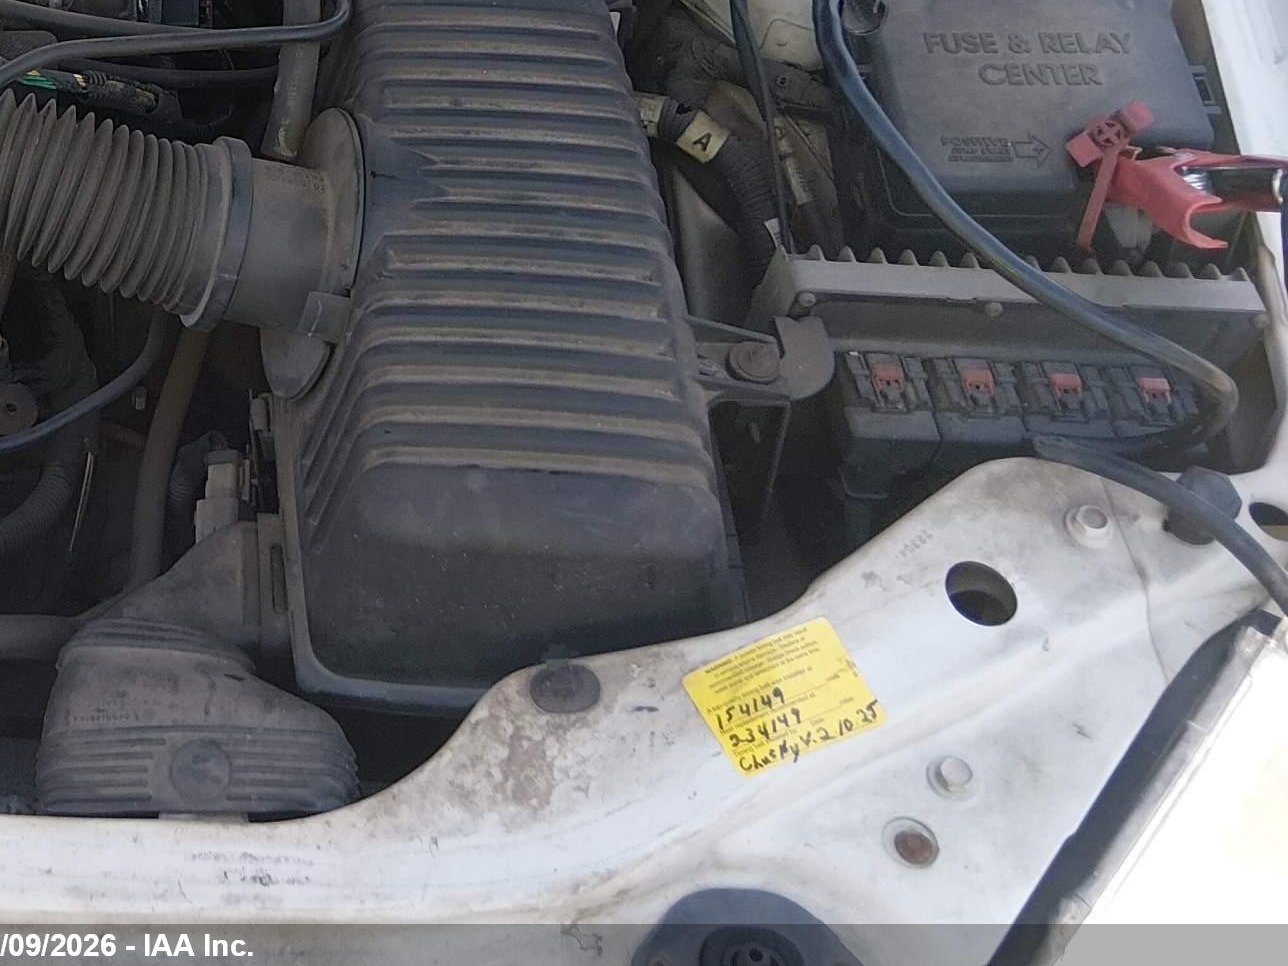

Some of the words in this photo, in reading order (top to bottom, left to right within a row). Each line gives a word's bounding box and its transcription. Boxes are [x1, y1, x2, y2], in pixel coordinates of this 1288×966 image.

[923, 32, 999, 55] FUSE
[1008, 32, 1032, 54] &
[1038, 32, 1132, 55] RELAY
[978, 62, 1104, 86] CENTER
[692, 132, 713, 152] A
[717, 686, 785, 731] 154149
[729, 707, 801, 747] 234149
